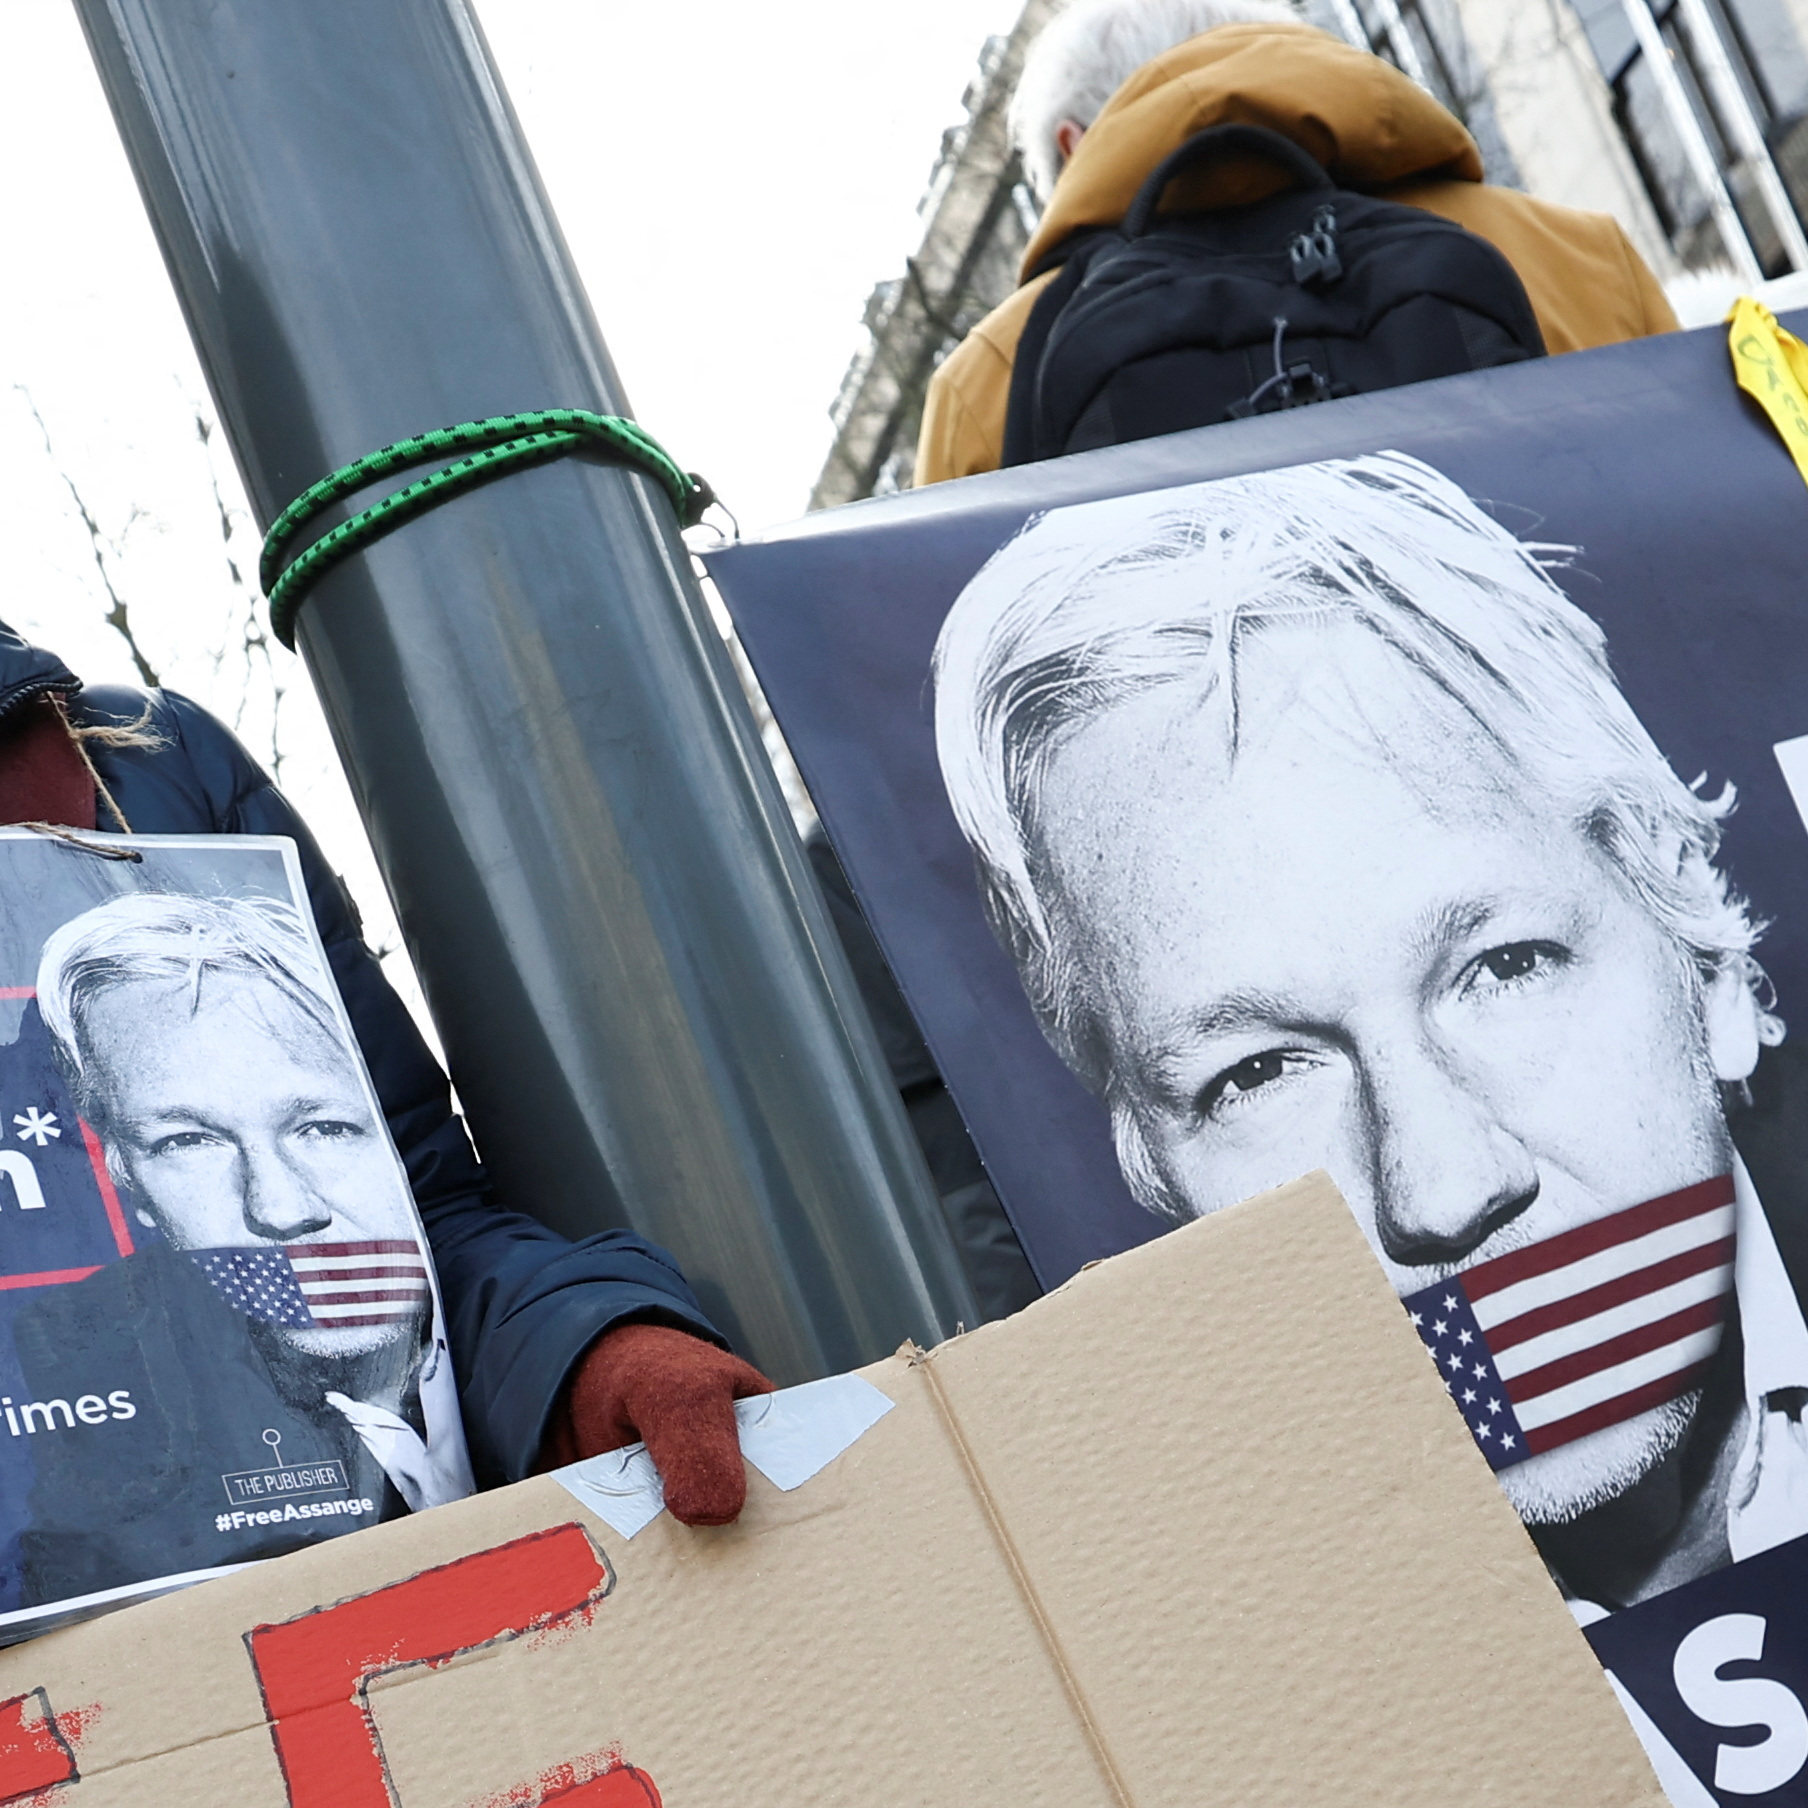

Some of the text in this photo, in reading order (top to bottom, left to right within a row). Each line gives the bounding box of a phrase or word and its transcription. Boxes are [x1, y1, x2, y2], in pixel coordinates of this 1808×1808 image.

[234, 1467, 339, 1497] THE PUBLISHER
[214, 1497, 375, 1532] #FreeAssange
